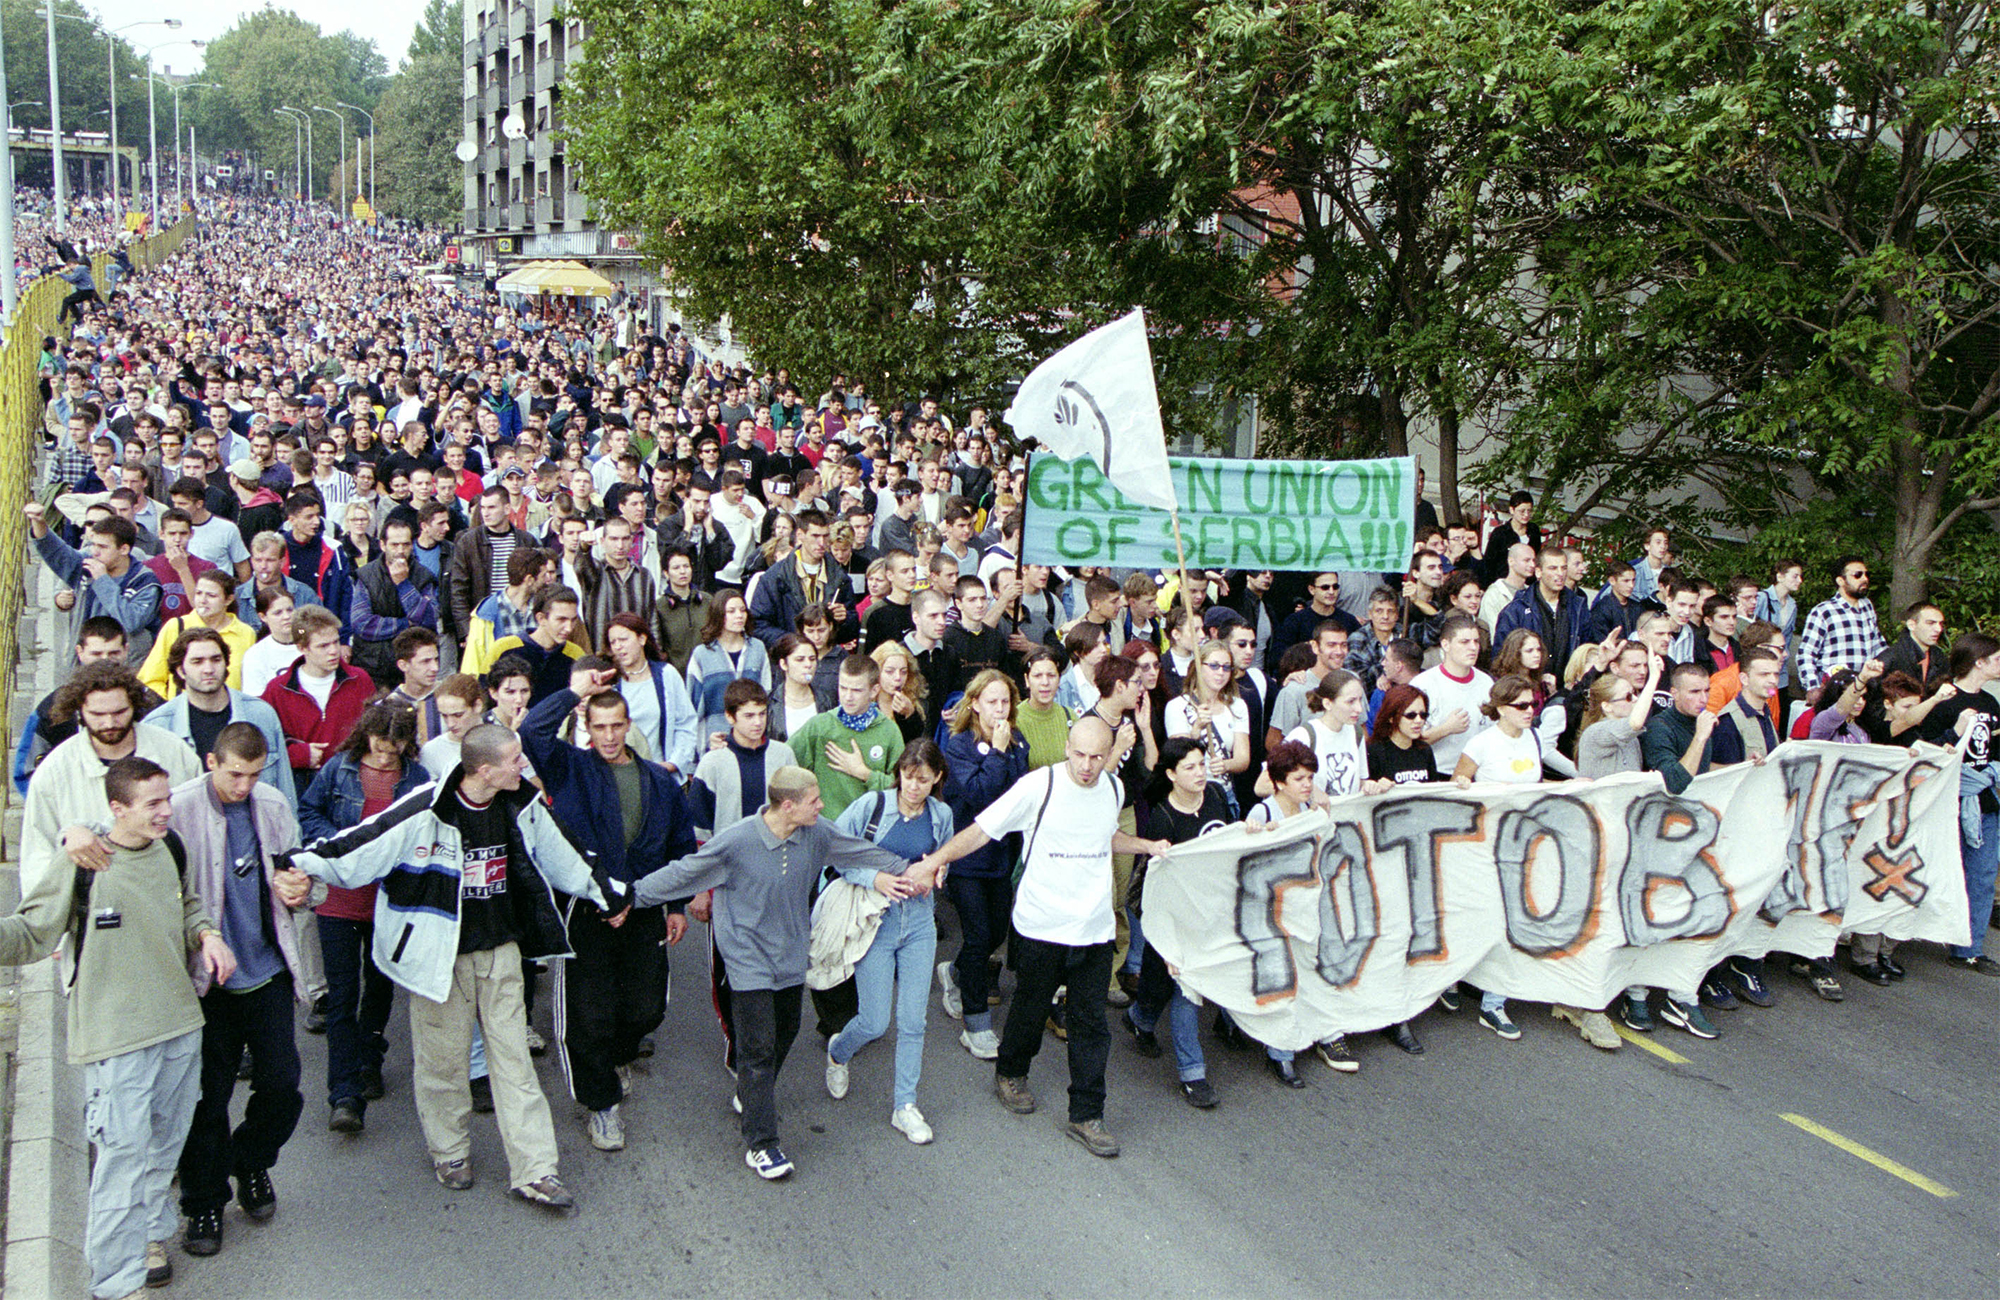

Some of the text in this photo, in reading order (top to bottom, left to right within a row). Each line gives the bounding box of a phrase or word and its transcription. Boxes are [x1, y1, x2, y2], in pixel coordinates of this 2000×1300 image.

[1243, 457, 1402, 519] UNION
[1055, 515, 1408, 569] OF SERBIA!!!
[1394, 769, 1429, 783] ОТПОР!
[1234, 791, 1737, 1006] ГОТОВ
